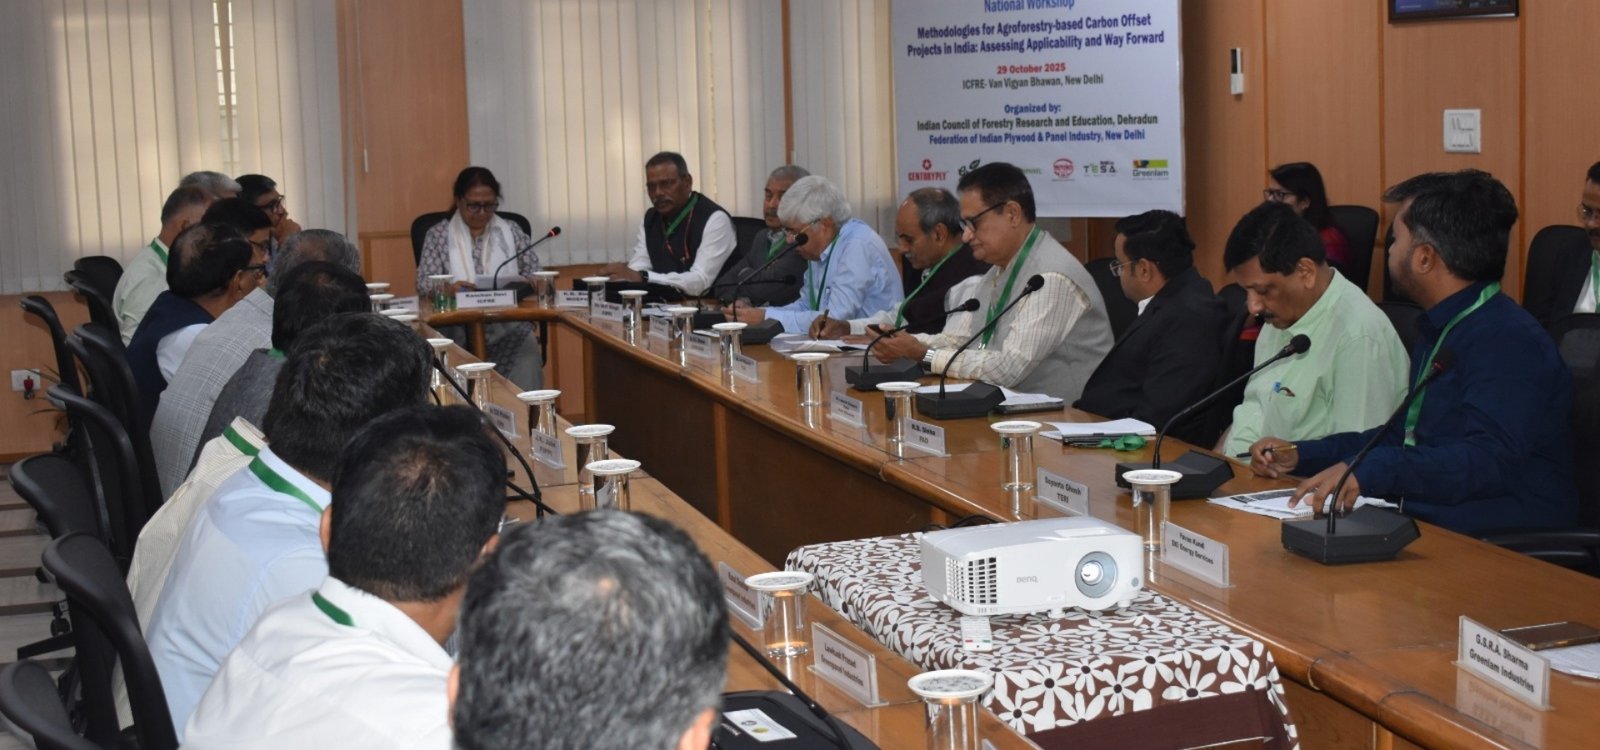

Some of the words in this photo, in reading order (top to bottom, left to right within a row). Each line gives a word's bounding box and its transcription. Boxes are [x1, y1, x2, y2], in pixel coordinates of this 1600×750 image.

[984, 0, 1024, 12] National
[1026, 0, 1075, 10] Workshop
[917, 24, 980, 39] Methodologies
[982, 22, 995, 35] for
[997, 17, 1083, 37] Agroforestry-based
[1086, 16, 1118, 29] Carbon
[1121, 14, 1152, 27] Offset
[907, 43, 942, 58] Projects
[944, 42, 952, 54] in
[954, 41, 978, 53] India:
[980, 38, 1025, 53] Assessing
[1027, 35, 1082, 52] Applicability
[1085, 34, 1102, 47] and
[1104, 33, 1124, 48] Way
[1126, 30, 1164, 45] Forward
[997, 65, 1007, 74] 29
[1009, 64, 1042, 73] October
[1045, 63, 1066, 72] 2025
[962, 79, 987, 90] ICFRE-
[989, 79, 1003, 89] Van
[1003, 77, 1029, 90] Vigyan
[1030, 76, 1063, 87] Bhawan,
[1065, 75, 1081, 85] New
[1083, 74, 1104, 84] Delhi
[1004, 103, 1046, 116] Organized
[1048, 103, 1061, 114] by:
[917, 120, 940, 131] Indian
[942, 119, 970, 130] Council
[972, 119, 980, 129] of
[982, 118, 1013, 130] Forestry
[1015, 116, 1053, 128] Research
[1055, 116, 1070, 127] and
[1072, 114, 1115, 127] Education,
[1117, 113, 1158, 125] Dehradun
[929, 134, 968, 145] Federation
[970, 133, 978, 143] of
[979, 132, 1003, 143] Indian
[1004, 131, 1036, 145] Plywood
[1037, 131, 1044, 142] &
[1045, 131, 1067, 142] Panel
[1069, 130, 1104, 143] Industry,
[1105, 130, 1122, 140] New
[1124, 128, 1145, 140] Delhi
[908, 172, 947, 181] CENTURYPLY
[1132, 169, 1169, 177] Greenlam
[1195, 550, 1214, 565] Services
[1475, 633, 1501, 656] G.S.R.A.
[1503, 648, 1529, 671] Sharma
[1469, 648, 1500, 674] Greenlam
[1501, 666, 1534, 693] Industries
